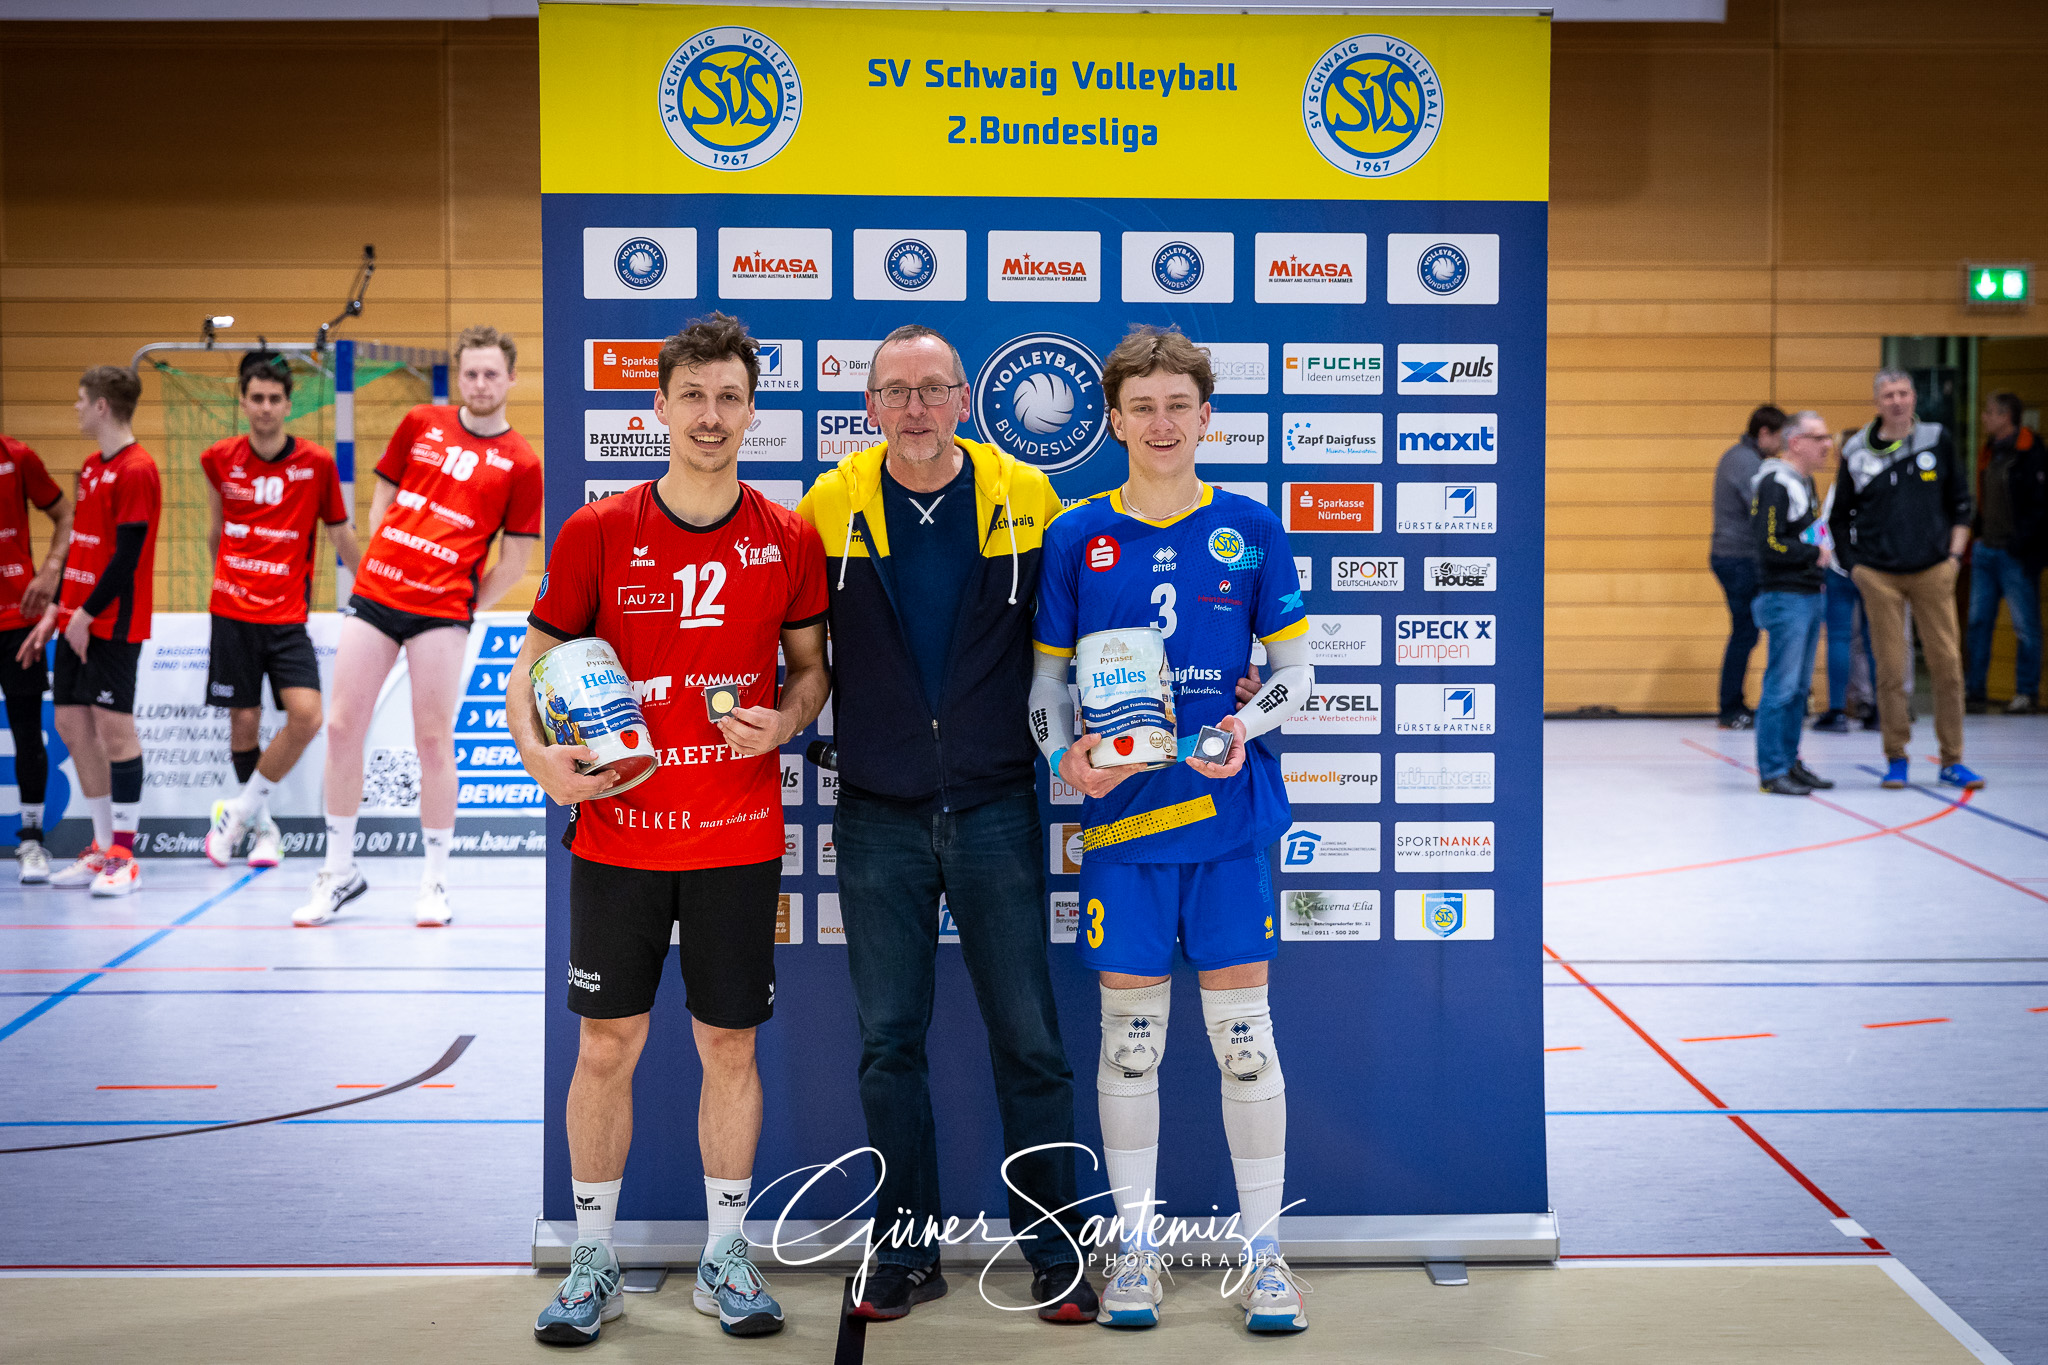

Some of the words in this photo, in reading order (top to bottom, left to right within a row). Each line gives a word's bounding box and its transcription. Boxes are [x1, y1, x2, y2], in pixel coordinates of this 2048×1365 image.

[664, 35, 715, 96] SCHWAIG
[1308, 43, 1359, 103] SCHWAIG
[742, 33, 797, 122] VOLLEYBALL
[868, 59, 911, 88] SV
[925, 59, 1057, 96] Schwaig
[1072, 61, 1238, 97] Volleyball
[1385, 42, 1438, 129] VOLLEYBALL
[664, 104, 679, 123] SV
[1308, 110, 1322, 129] SV
[947, 116, 1159, 153] 2.Bundesliga
[713, 153, 749, 165] 1967
[1355, 160, 1391, 172] 1967
[621, 243, 661, 261] VOLLEYBALL
[891, 244, 930, 262] VOLLEYBALL
[1158, 248, 1198, 265] VOLLEYBALL
[1424, 249, 1463, 267] VOLLEYBALL
[732, 253, 818, 273] MIKASA
[1002, 256, 1087, 276] MIKASA
[1268, 258, 1353, 277] MIKASA
[622, 269, 661, 285] BUNDESLIGA
[892, 270, 930, 286] BUNDESLIGA
[1159, 273, 1198, 289] BUNDESLIGA
[1425, 274, 1463, 290] BUNDESLIGA
[621, 356, 659, 368] Sparkas
[1308, 357, 1381, 370] FUCHS
[1450, 356, 1494, 382] puls
[622, 369, 660, 378] Nürnber
[992, 351, 1093, 394] VOLLEYBALL
[1307, 372, 1334, 382] Ideen
[1335, 373, 1381, 382] umsetzen
[757, 380, 800, 388] ARTNER
[821, 415, 880, 435] SPEC
[590, 432, 671, 445] BAUMÜLLE
[995, 418, 1093, 457] BUNDESLIGA
[1297, 434, 1324, 446] Zapf
[1326, 434, 1376, 447] Daigfuss
[1399, 426, 1494, 452] maxit
[440, 445, 480, 482] 18
[250, 475, 285, 506] 10
[1318, 498, 1365, 509] Sparkasse
[1318, 511, 1362, 522] Nürnberg
[1398, 520, 1432, 530] FÜRST
[1435, 522, 1442, 530] &
[1445, 522, 1494, 530] PARTNER
[750, 548, 761, 559] TV
[1152, 563, 1177, 573] errea
[1337, 561, 1399, 579] SPORT
[673, 561, 727, 618] 12
[1337, 579, 1399, 587] DEUTSCHLAND.TV
[1435, 575, 1485, 587] HOUSE
[624, 594, 646, 605] AU
[649, 593, 665, 604] 72
[1150, 582, 1178, 640] 3
[1398, 620, 1469, 639] SPECK
[1308, 640, 1367, 650] OCKERHOF
[1398, 644, 1470, 663] pumpen
[1100, 655, 1133, 665] Pyraser
[580, 669, 630, 690] Helles
[1092, 667, 1147, 689] Helles
[1302, 695, 1379, 712] EYSEL
[1287, 714, 1309, 722] ruck
[1318, 714, 1378, 722] Werbetechnik
[1397, 722, 1431, 731] FÜRST
[1444, 723, 1492, 731] PARTNER
[469, 745, 522, 767] BERA
[459, 783, 545, 804] BEWERT
[700, 818, 724, 828] man
[749, 807, 770, 821] sich!
[1397, 836, 1492, 847] SPORTNANKA
[1397, 849, 1492, 859] www.sportnanka.de
[1313, 901, 1350, 911] Taverna
[1352, 901, 1374, 911] Elia
[1086, 898, 1105, 949] 3
[1128, 1031, 1151, 1039] errea
[1230, 1035, 1254, 1044] errea
[575, 1203, 602, 1211] erima
[718, 1200, 746, 1208] erima
